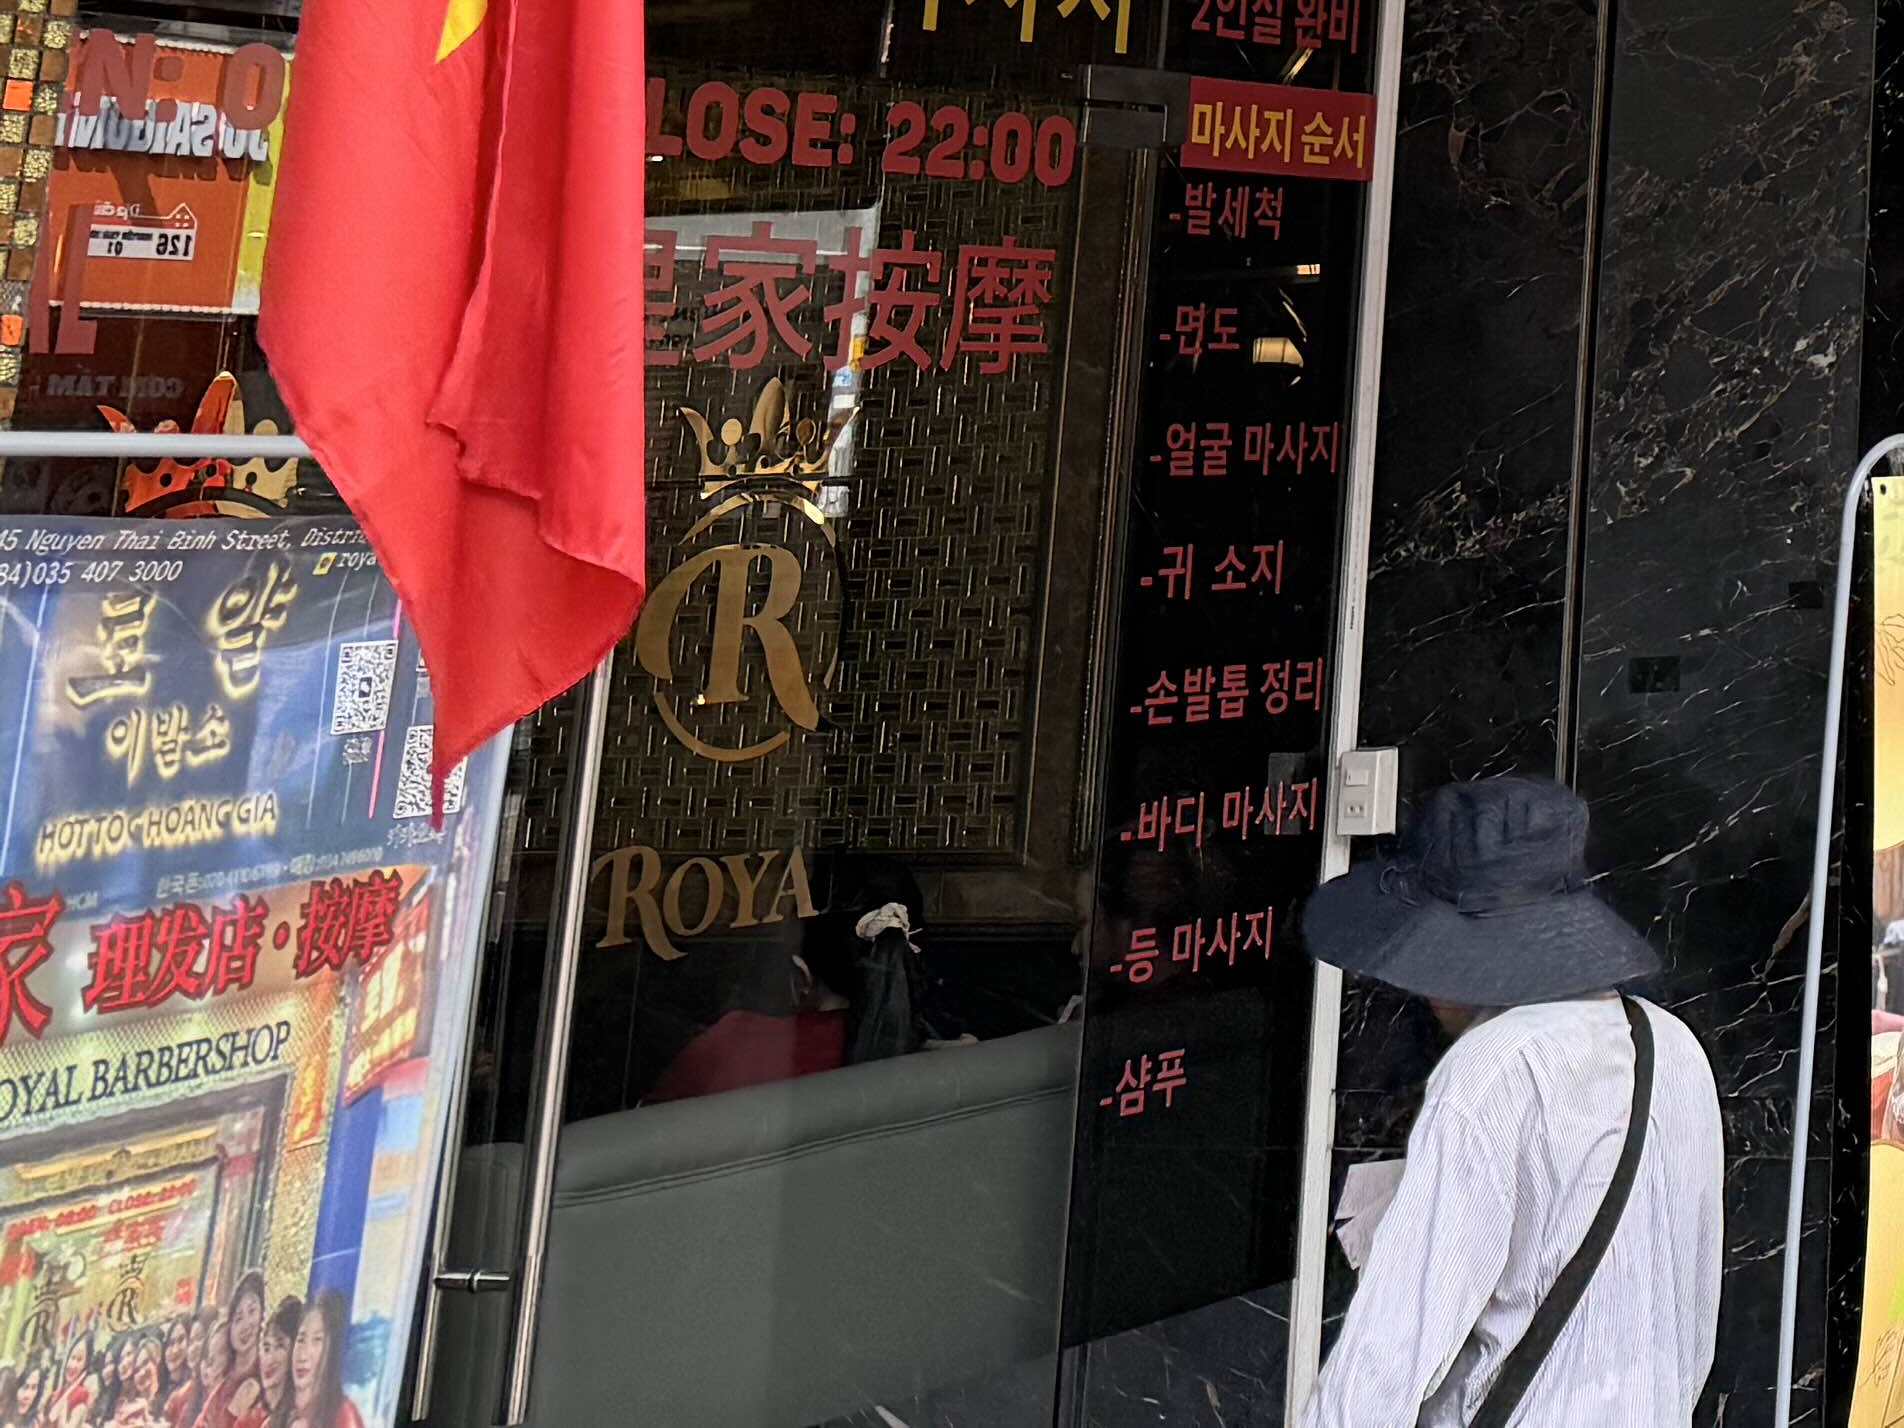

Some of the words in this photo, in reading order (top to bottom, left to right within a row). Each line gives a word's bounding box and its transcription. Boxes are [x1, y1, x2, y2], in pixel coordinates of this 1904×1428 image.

[643, 74, 854, 168] LOSE:
[880, 99, 1077, 188] 22:00
[1191, 101, 1294, 164] 마사지
[1300, 110, 1369, 169] 순서
[1168, 182, 1284, 242] -발세척
[1159, 304, 1240, 356] -면도
[1149, 422, 1233, 477] -얼굴
[1244, 421, 1340, 477] 마사지
[25, 529, 108, 556] Nguyen
[112, 529, 164, 551] Thai
[167, 529, 217, 551] Binh
[81, 560, 124, 582] 407
[128, 560, 184, 582] 3000
[1140, 543, 1195, 600] -귀
[1211, 540, 1285, 596] 소지
[1130, 662, 1250, 726] -손발톱
[1260, 657, 1325, 715] 정리
[105, 702, 234, 790] 이발소
[1119, 790, 1205, 853] -바디
[1221, 775, 1320, 841] 마사지
[1109, 925, 1160, 984] -등
[1171, 906, 1274, 976] 마사지
[89, 1020, 292, 1101] BARBERSHOP
[1099, 1047, 1188, 1118] -샴푸
